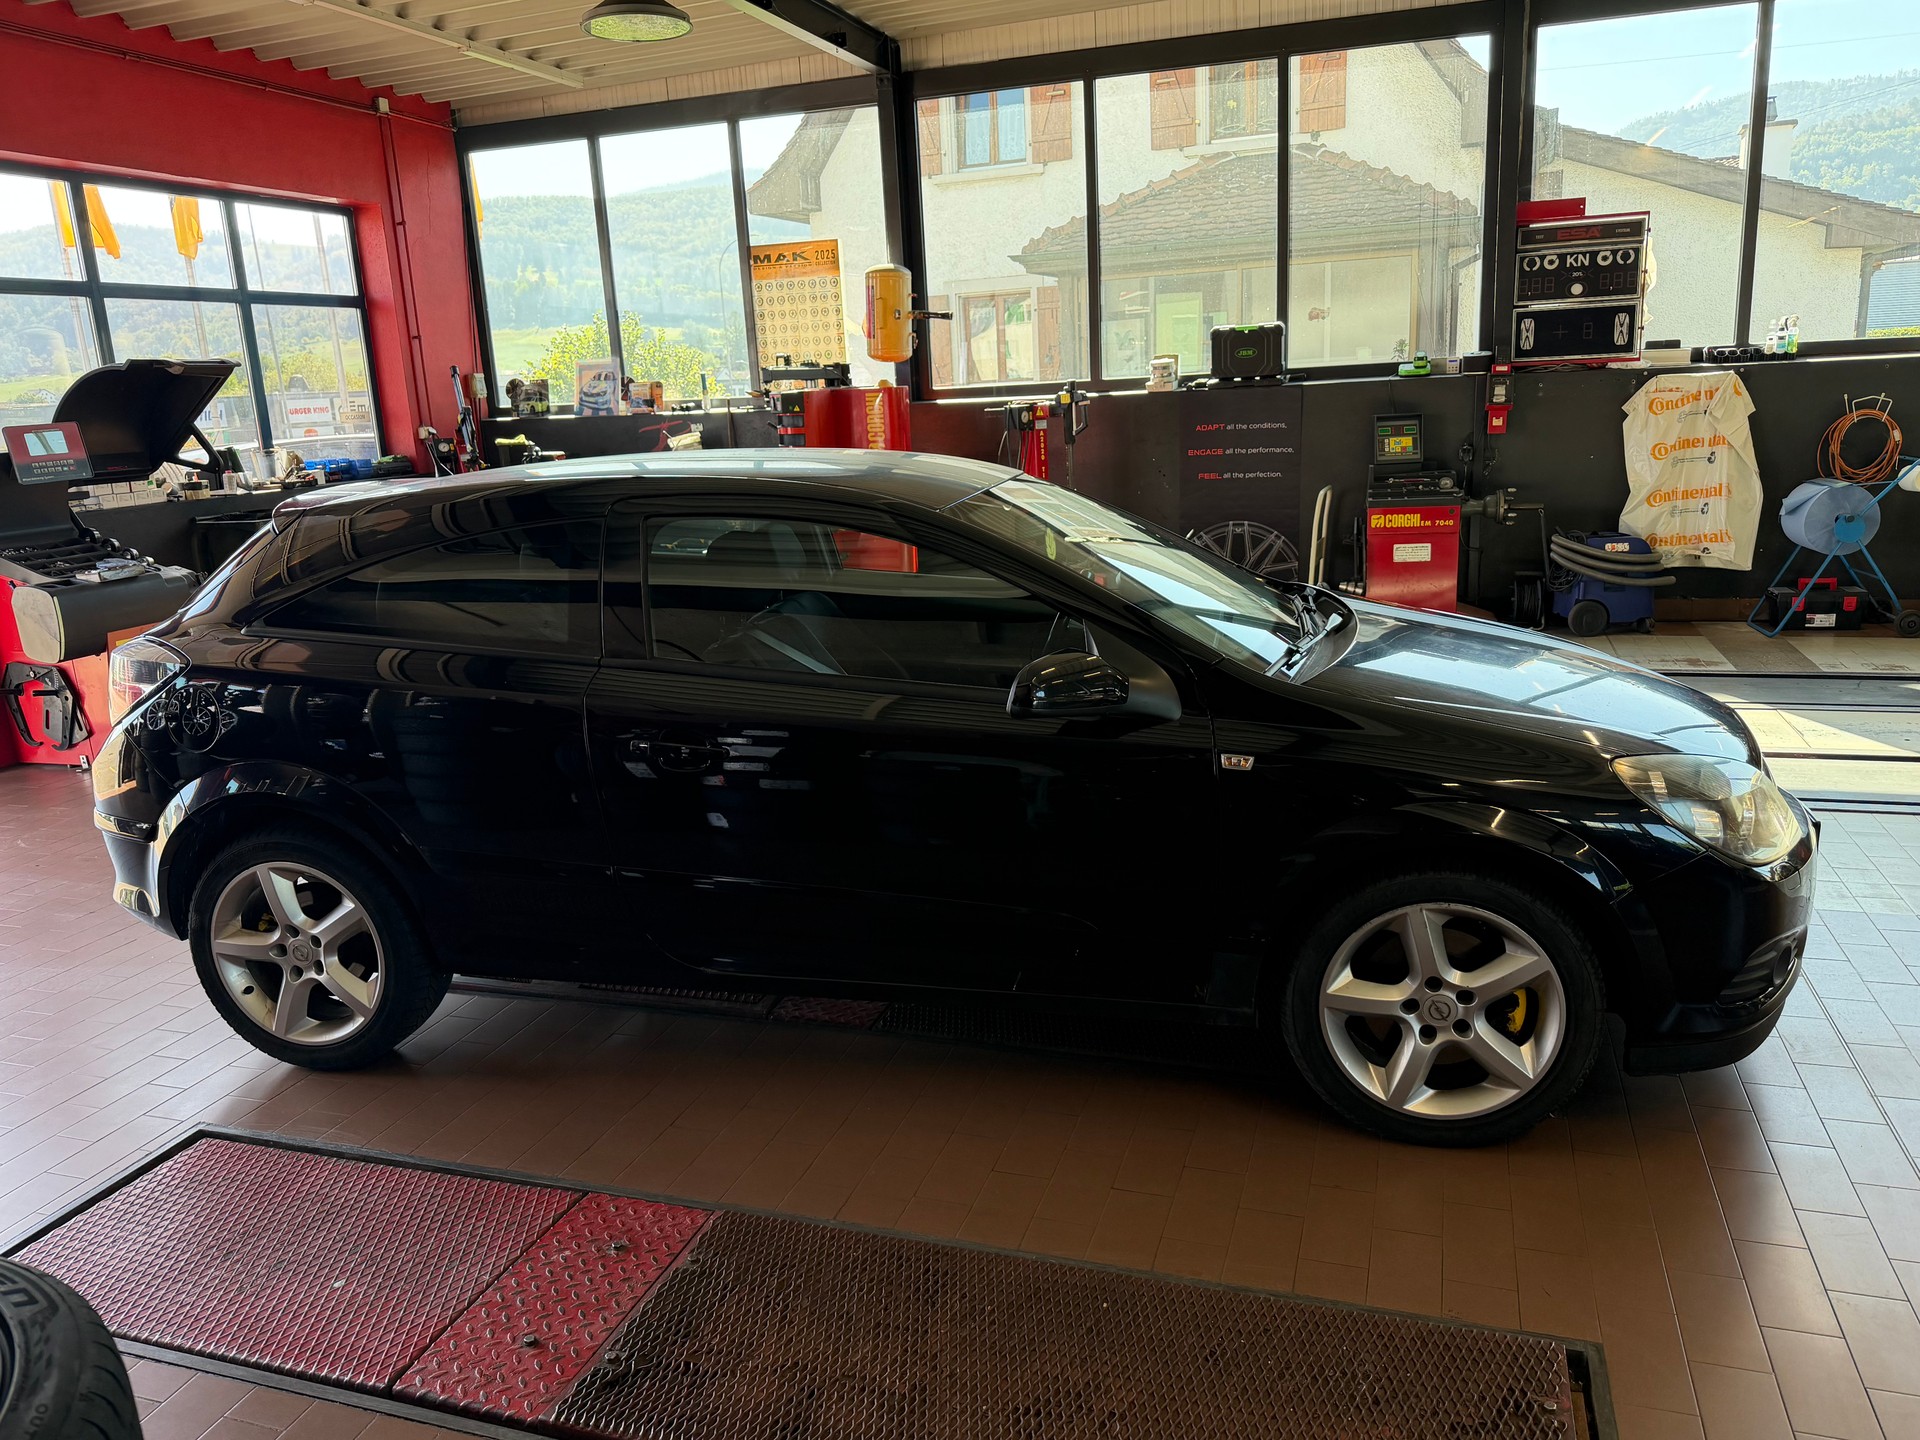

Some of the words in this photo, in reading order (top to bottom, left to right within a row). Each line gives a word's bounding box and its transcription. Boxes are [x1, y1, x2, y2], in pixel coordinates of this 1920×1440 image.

[1556, 226, 1602, 240] ESA
[753, 251, 810, 264] MAK
[814, 249, 836, 261] 2025
[1566, 253, 1590, 268] KN
[288, 406, 311, 416] URGER
[312, 405, 330, 414] KING
[344, 413, 366, 421] OCCASION
[1195, 423, 1225, 431] ADAPT
[1187, 448, 1224, 456] ENGAGE
[1198, 472, 1222, 480] FEEL
[1245, 471, 1282, 479] perfection.
[1385, 513, 1421, 528] CORGHI
